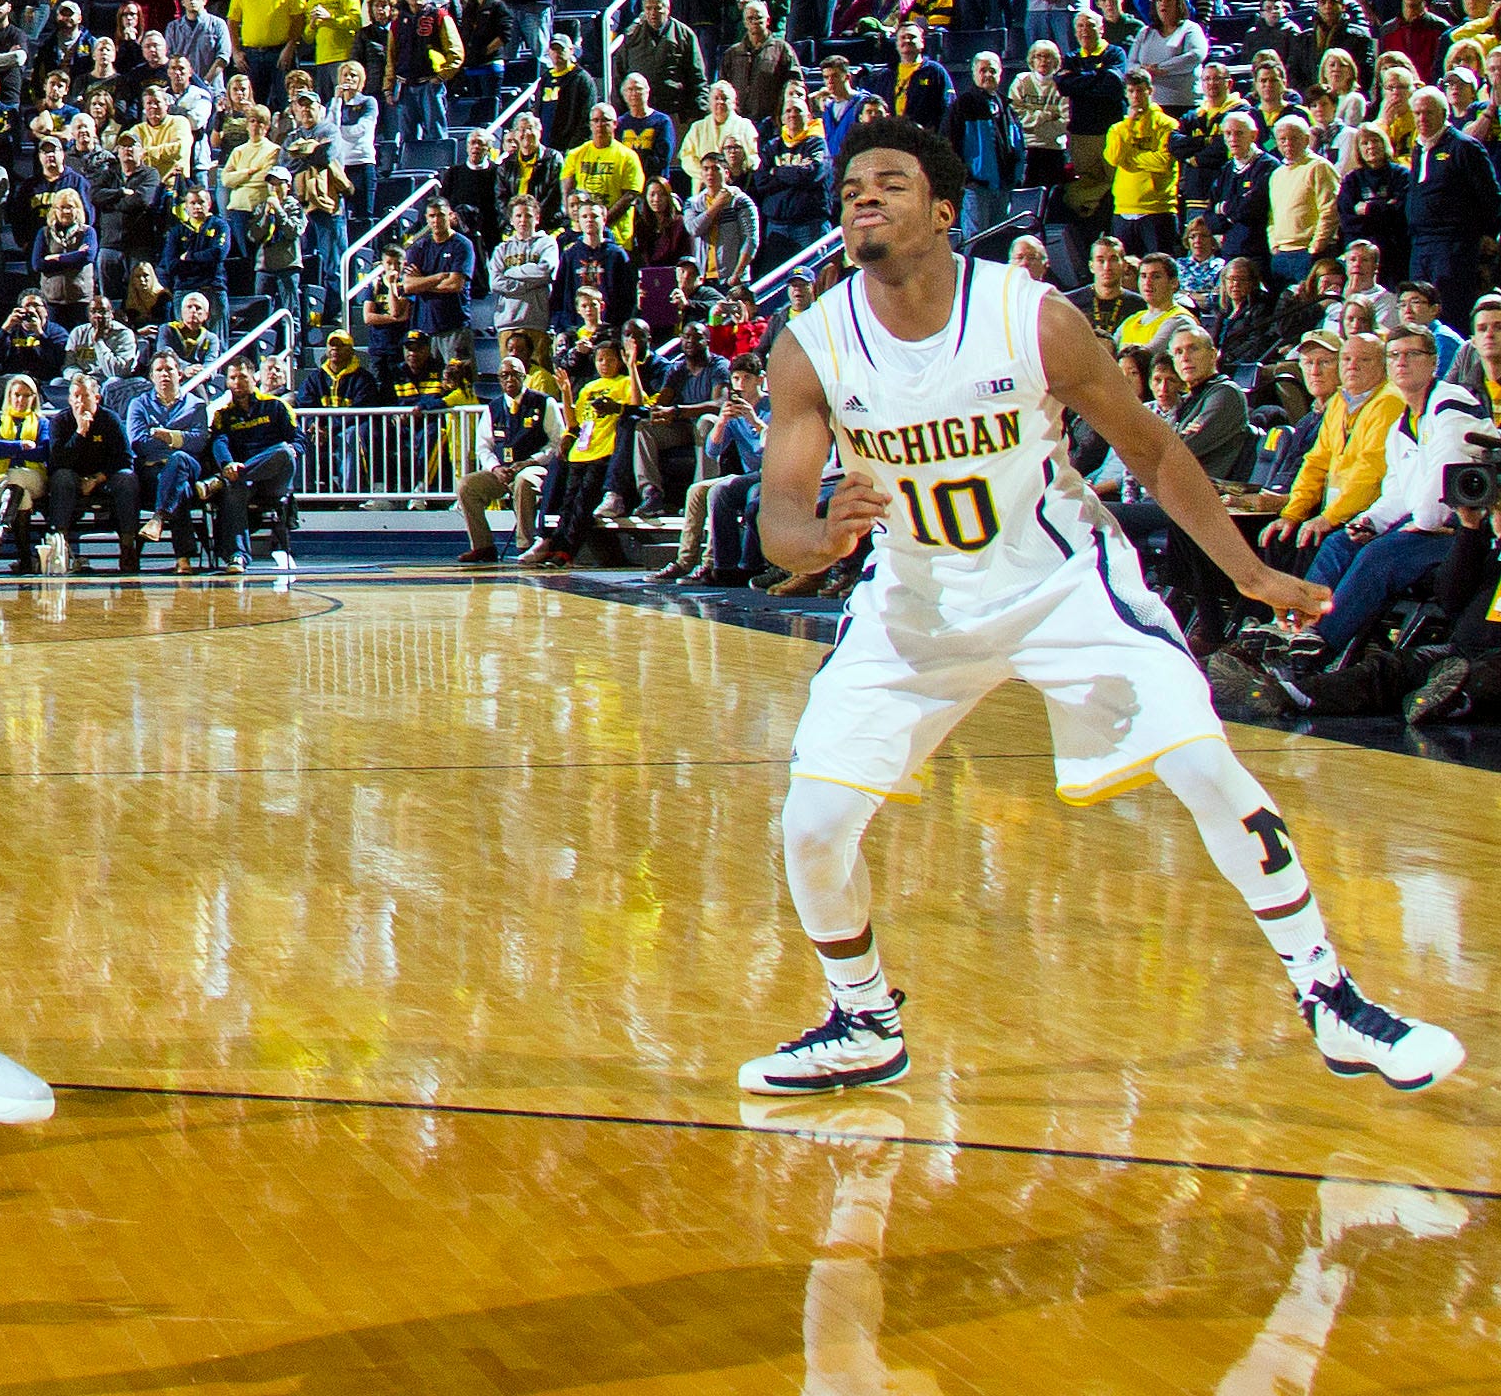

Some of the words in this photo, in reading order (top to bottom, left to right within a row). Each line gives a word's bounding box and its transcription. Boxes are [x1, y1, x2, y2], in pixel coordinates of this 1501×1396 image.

[417, 15, 434, 36] S
[622, 128, 656, 150] M
[842, 409, 1020, 465] MICHIGAN
[897, 475, 1001, 553] 10
